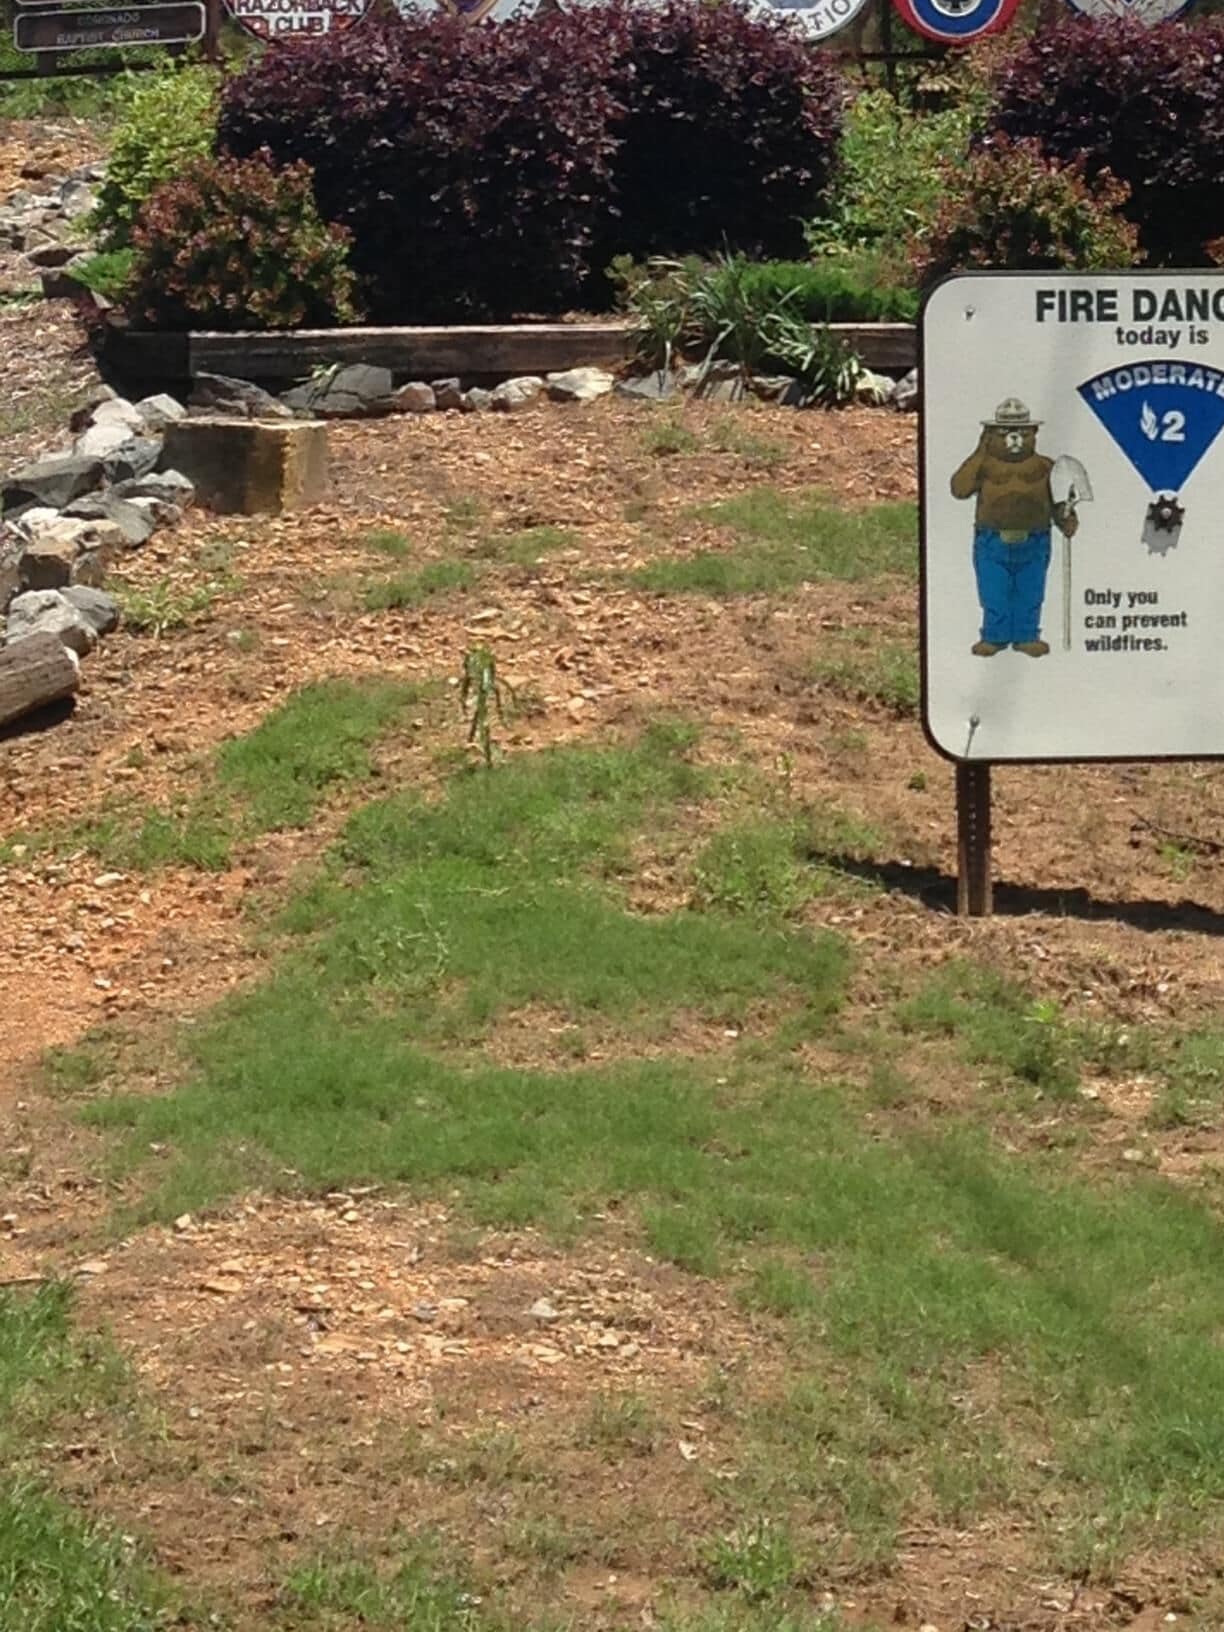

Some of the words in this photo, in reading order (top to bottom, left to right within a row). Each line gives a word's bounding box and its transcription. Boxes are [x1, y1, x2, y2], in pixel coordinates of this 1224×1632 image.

[274, 16, 325, 34] CLUB
[1036, 288, 1118, 323] FIRE
[1116, 325, 1179, 349] today
[1189, 324, 1209, 345] is
[1162, 411, 1185, 441] 2
[1084, 588, 1121, 608] Only
[1127, 591, 1158, 608] you
[1084, 615, 1116, 628] can
[1121, 614, 1187, 631] prevent
[1084, 635, 1168, 652] wildfires.
